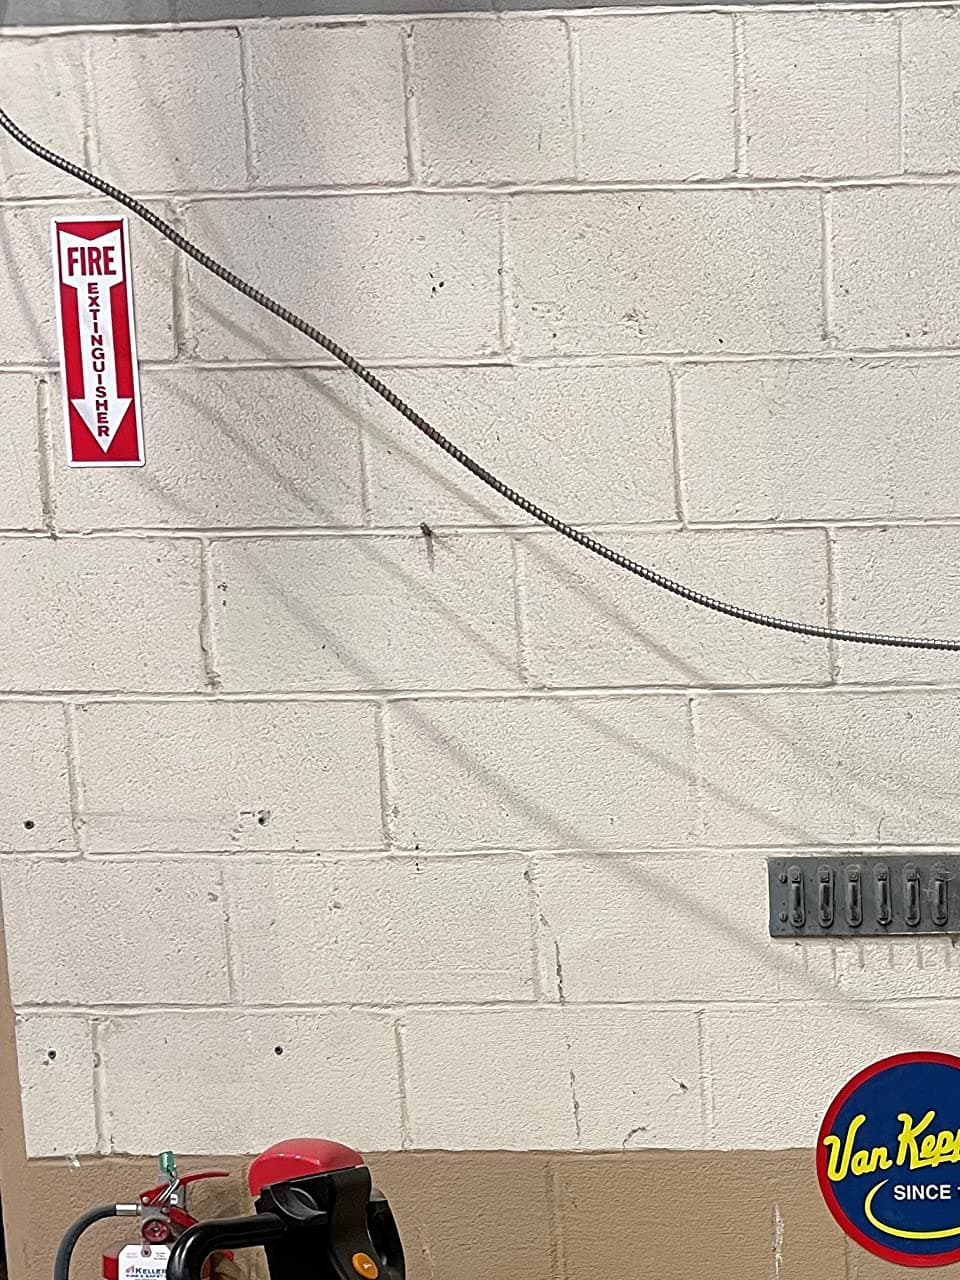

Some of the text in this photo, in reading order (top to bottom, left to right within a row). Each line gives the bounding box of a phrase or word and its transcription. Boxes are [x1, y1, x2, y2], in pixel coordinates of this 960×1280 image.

[67, 246, 117, 276] FIRE
[87, 282, 110, 437] EXTINGUISHER
[823, 1114, 893, 1181] Van
[893, 1184, 952, 1200] SINCE
